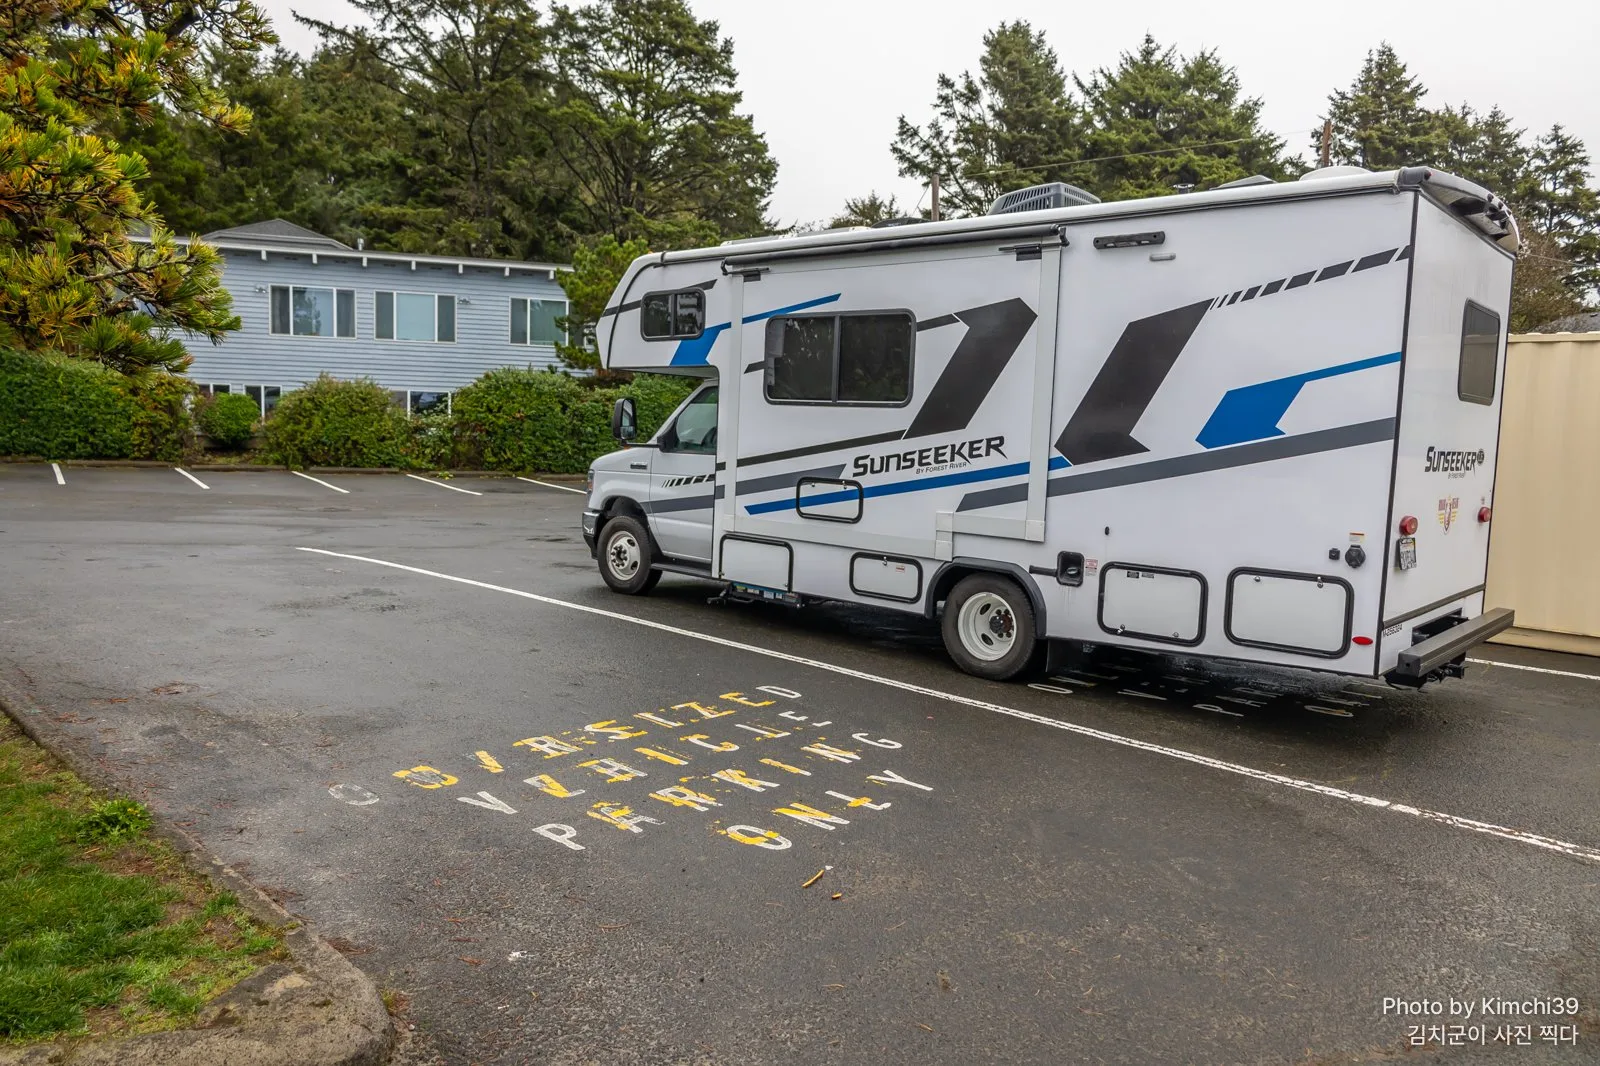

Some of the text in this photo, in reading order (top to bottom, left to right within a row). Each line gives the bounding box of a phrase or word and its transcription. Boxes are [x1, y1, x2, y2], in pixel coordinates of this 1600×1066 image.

[852, 435, 1008, 478] SUNSEEKER
[915, 461, 968, 475] BY FOREST RIVER
[1424, 446, 1476, 475] SUNSEEKER
[718, 769, 934, 851] ONLY
